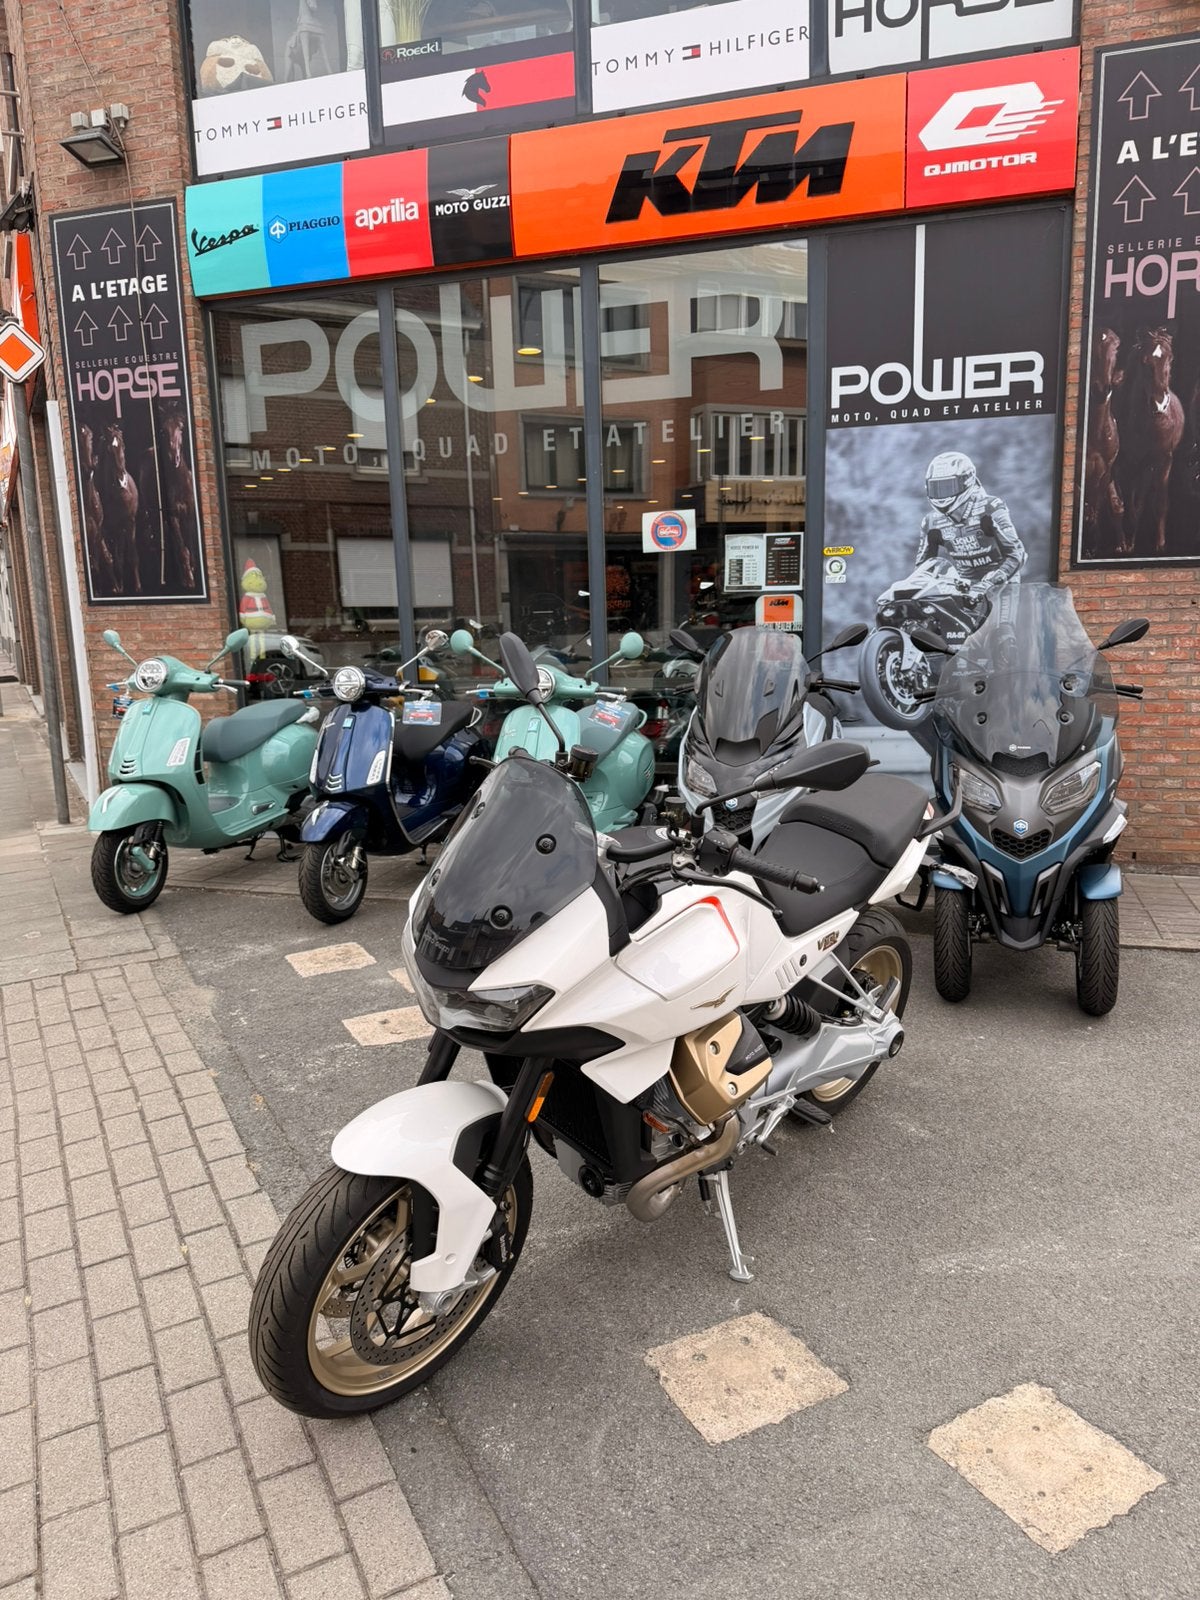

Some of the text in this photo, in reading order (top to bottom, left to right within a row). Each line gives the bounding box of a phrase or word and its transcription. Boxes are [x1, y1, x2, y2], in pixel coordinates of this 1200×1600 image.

[396, 41, 441, 58] Roeckl
[592, 25, 810, 76] TOMMY HILFIGER
[193, 101, 368, 143] TOMMY HILFIGER
[923, 151, 1038, 178] QJMOTOR
[1116, 131, 1200, 165] A L'E
[605, 109, 855, 225] KTM
[355, 196, 419, 231] aprilia
[435, 194, 511, 216] MOTO GUZZI
[190, 223, 260, 257] Vespa
[288, 215, 341, 232] PIAGGIO
[1107, 237, 1183, 254] SELLERIE
[71, 273, 169, 302] A L'ETAGE
[831, 224, 1045, 409] POWER
[75, 351, 179, 369] SELLERIE EQUESTRE
[241, 271, 784, 433] POWER
[75, 362, 182, 419] HORSE
[831, 399, 1044, 424] MOTO, QUAD ET ATELIER
[411, 432, 509, 461] QUAD
[542, 426, 583, 451] ET
[605, 410, 786, 448] ATELIER
